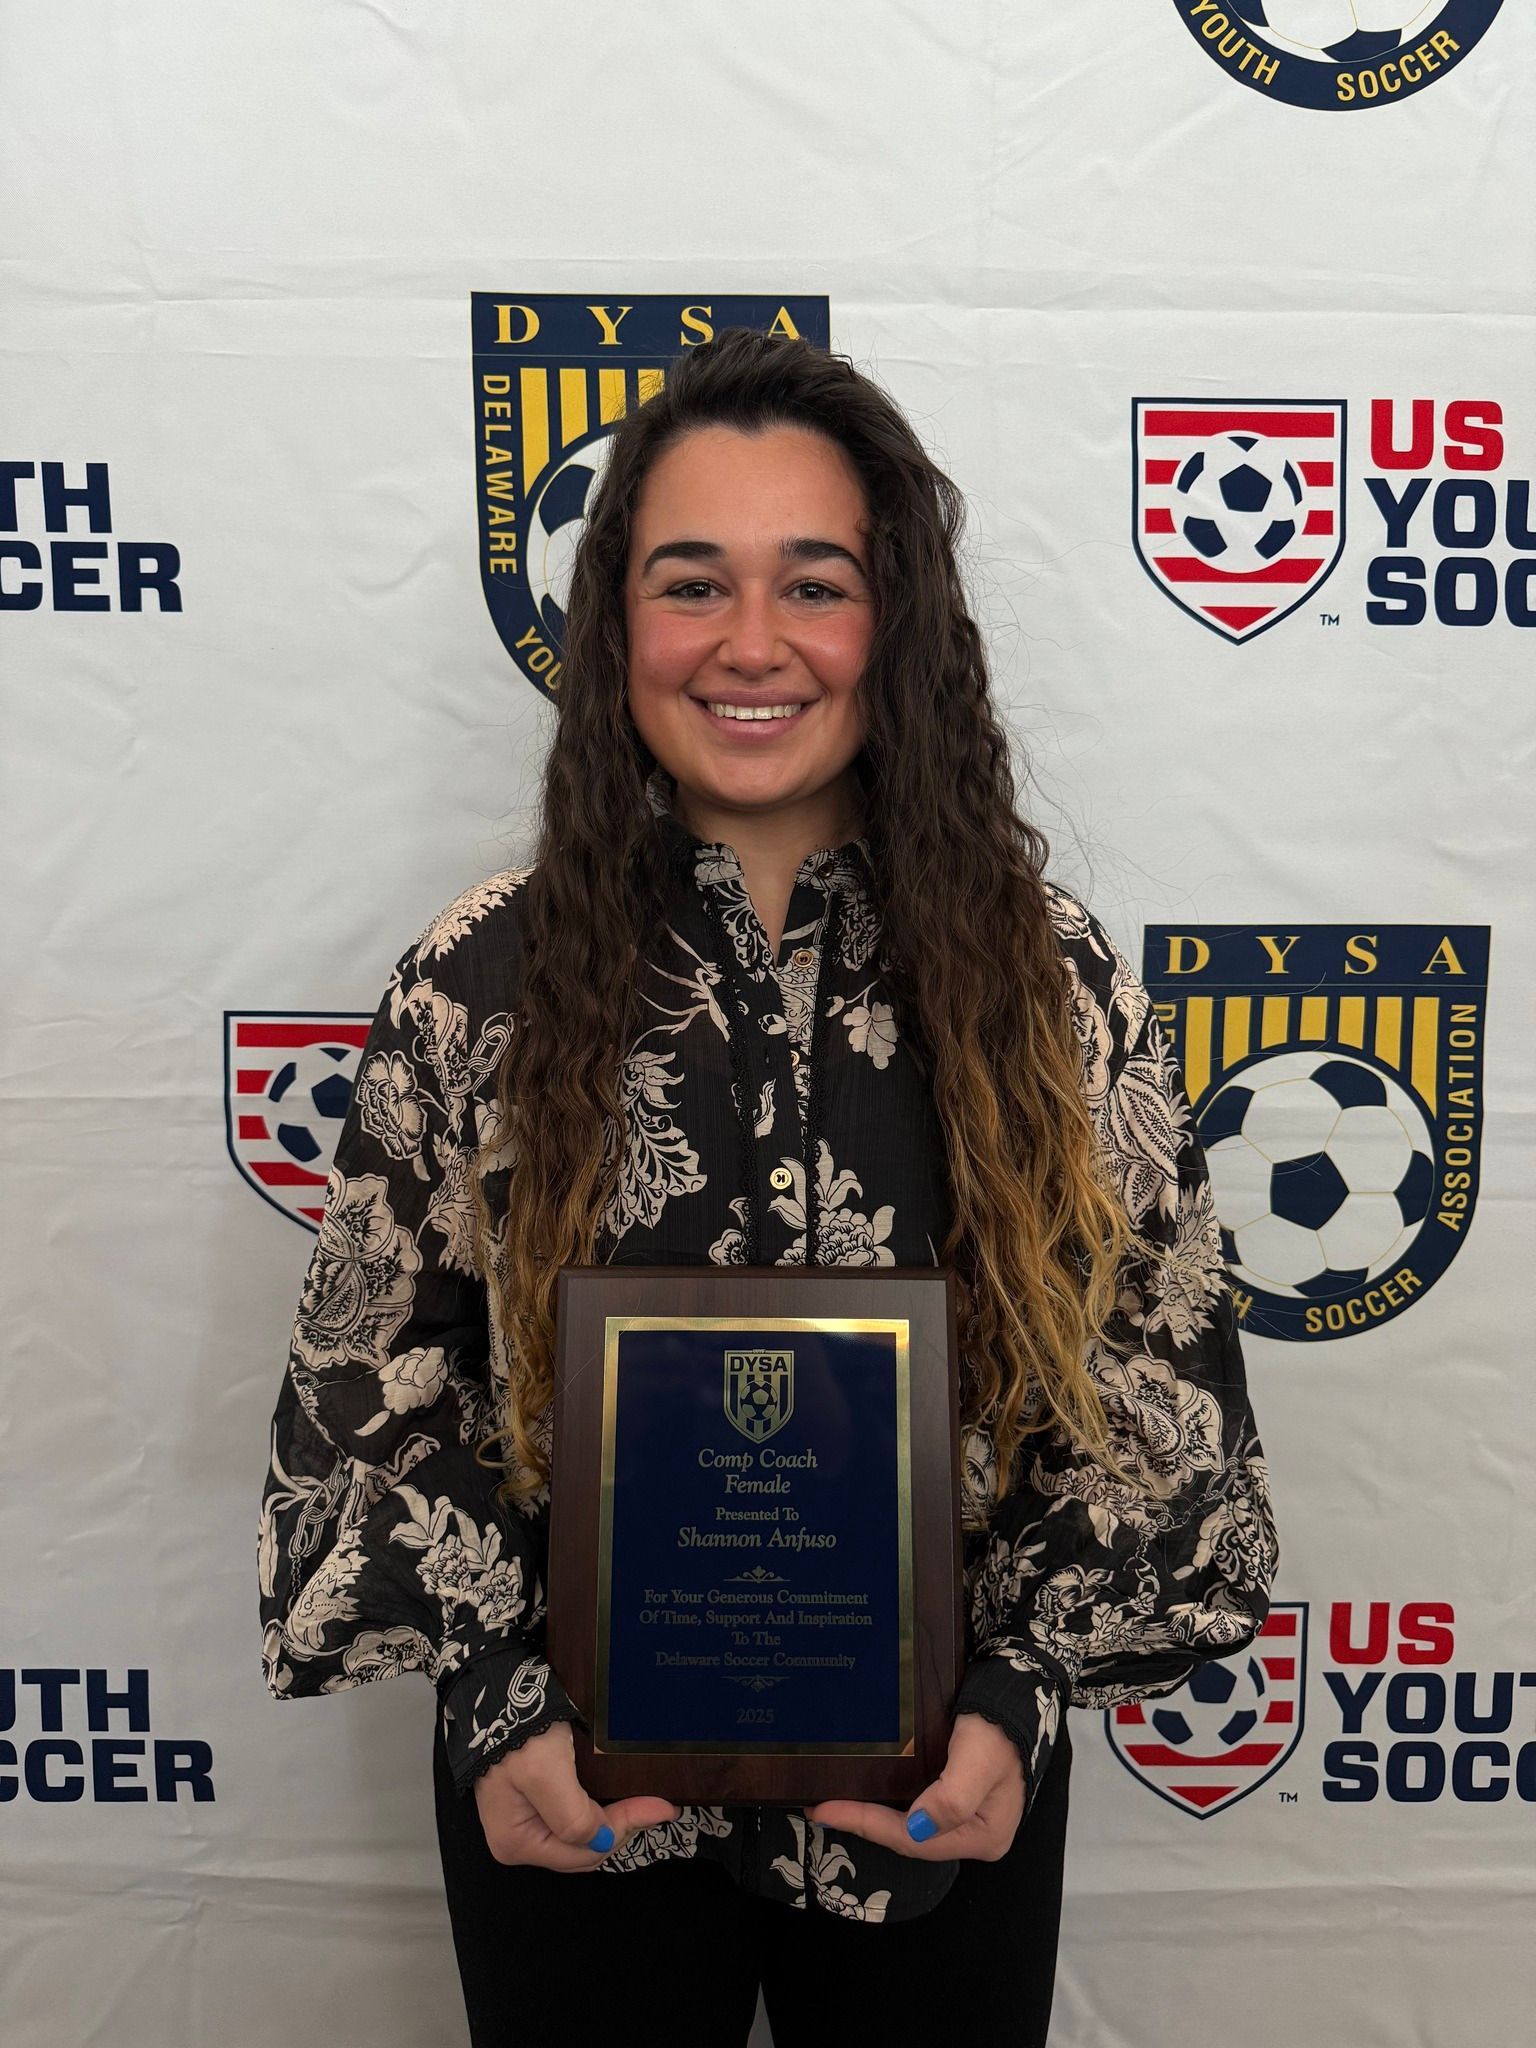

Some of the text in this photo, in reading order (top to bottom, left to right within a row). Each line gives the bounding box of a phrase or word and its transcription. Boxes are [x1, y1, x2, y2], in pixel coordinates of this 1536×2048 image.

[1190, 0, 1281, 85] YOUTH
[1336, 30, 1461, 102] SOCCER
[1371, 399, 1504, 471] US
[483, 375, 517, 575] DELAWARE
[1319, 614, 1340, 627] TM
[1163, 935, 1467, 976] DYSA
[1437, 1003, 1477, 1232] ASSOCIATION
[1305, 1267, 1423, 1334] SOCCER
[730, 1356, 788, 1372] DYSA
[698, 1449, 818, 1473] Comp Coach
[724, 1474, 791, 1494] Female
[715, 1507, 800, 1521] Presented To
[677, 1527, 837, 1552] Shannon Anfuso
[643, 1589, 869, 1605] For Your Generous Commitment
[639, 1611, 873, 1628] Of Time, Support And Inspiration
[731, 1631, 781, 1646] To The
[1329, 1602, 1455, 1665] US
[655, 1652, 856, 1671] Delaware Soccer Community
[0, 1669, 150, 1732] TH
[1322, 1672, 1536, 1734] YOU
[735, 1708, 774, 1724] 2025
[1278, 1792, 1299, 1803] TM
